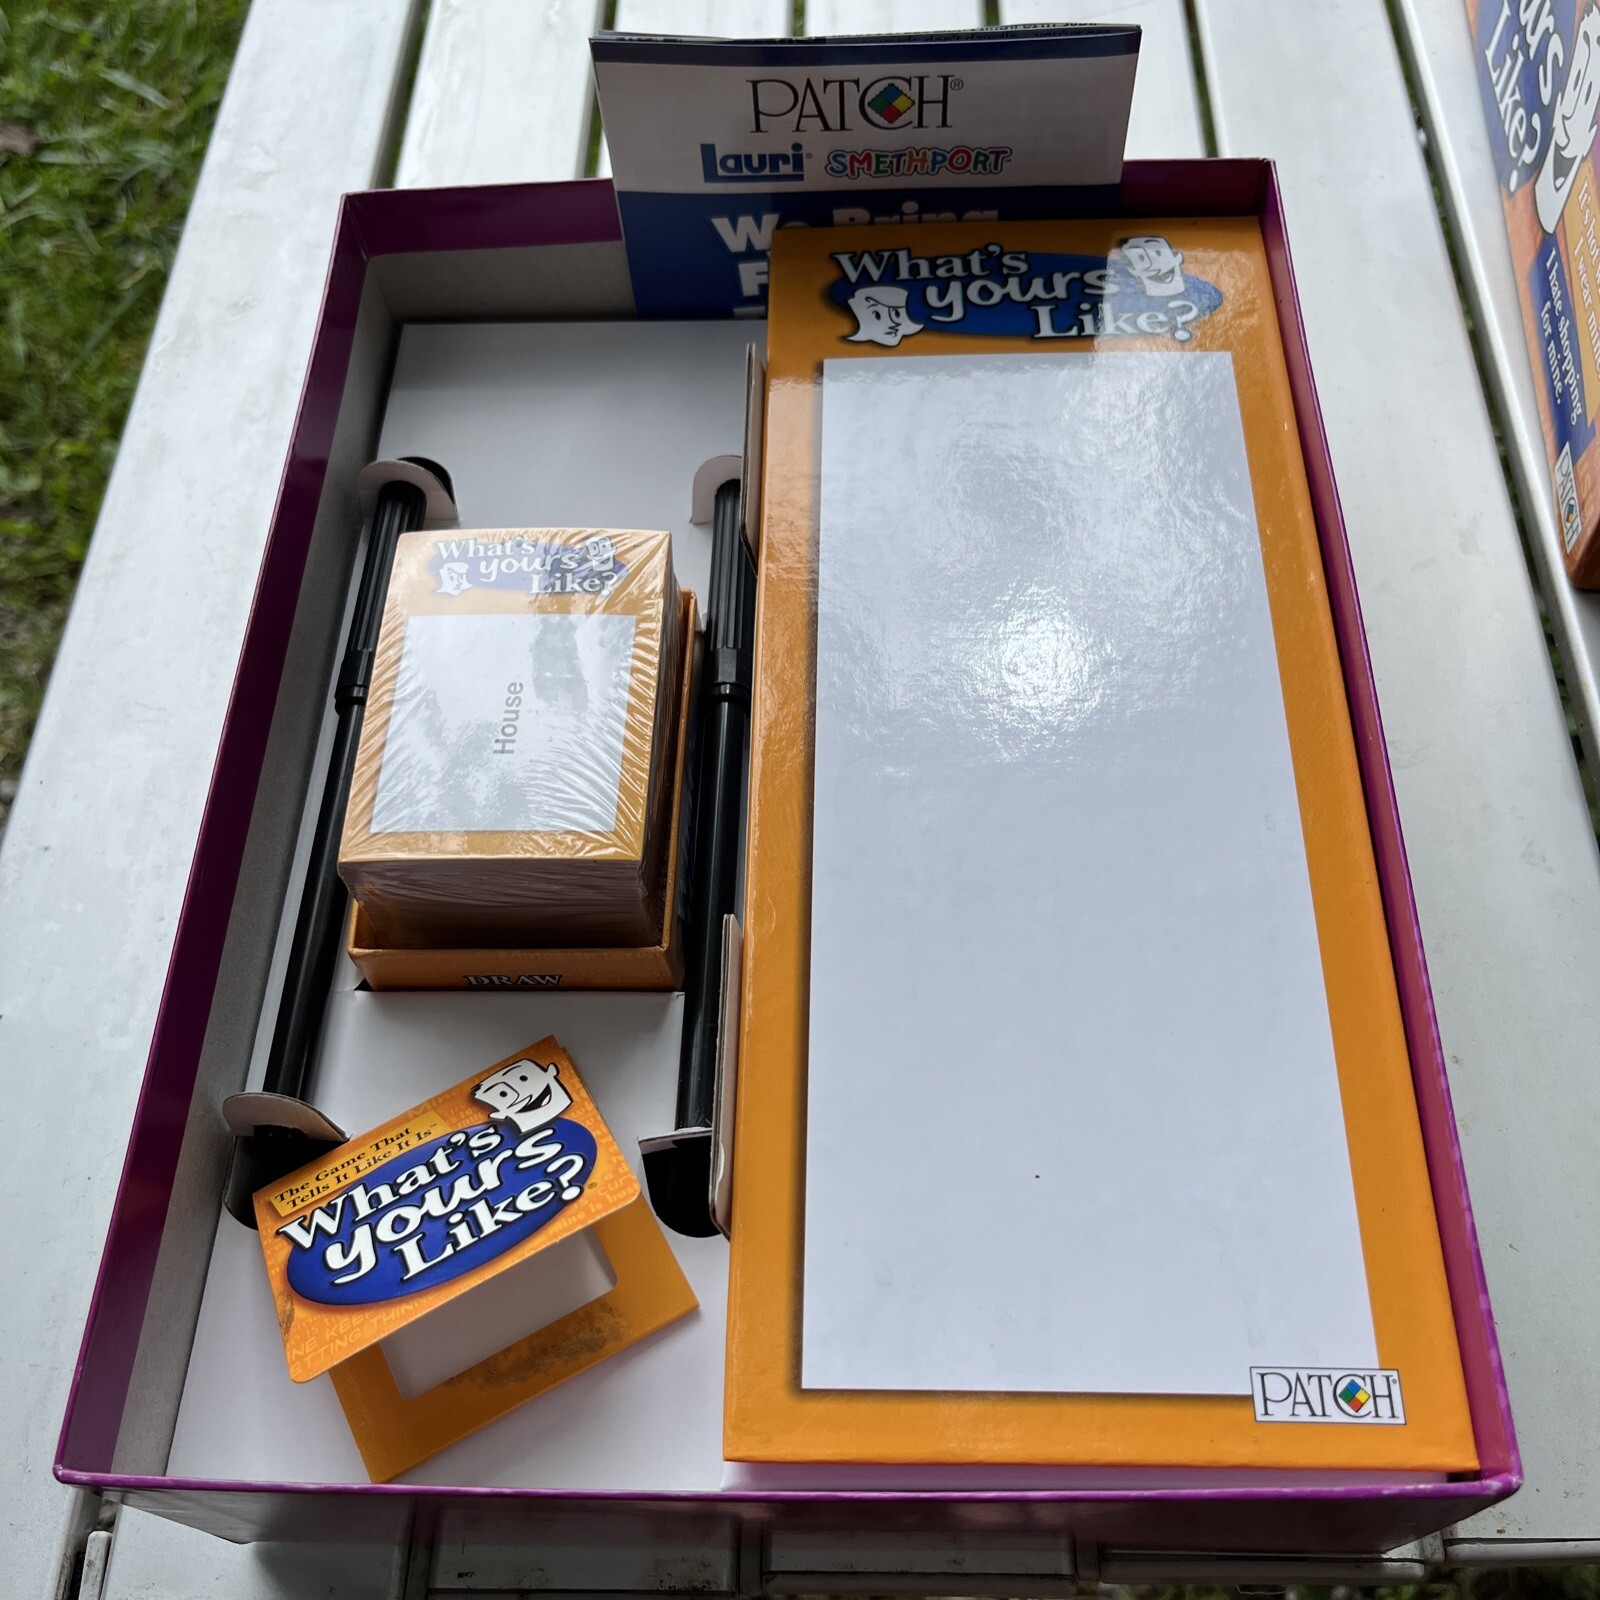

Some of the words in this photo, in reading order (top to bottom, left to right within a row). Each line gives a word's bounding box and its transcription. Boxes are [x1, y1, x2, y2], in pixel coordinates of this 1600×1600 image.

[746, 75, 955, 133] PATCH
[1485, 0, 1541, 193] Like?
[700, 143, 804, 183] Lauri
[825, 145, 1012, 179] SMETHPORT
[833, 243, 1030, 284] What's
[925, 270, 1122, 322] yours
[1030, 299, 1199, 342] Like?
[1541, 300, 1552, 338] for
[1547, 339, 1563, 405] mine.
[1549, 261, 1563, 317] hate
[1558, 315, 1582, 425] shopping
[1557, 450, 1579, 547] PATCH
[436, 534, 538, 560] What's
[478, 550, 582, 583] yours
[528, 571, 618, 597] Like?
[492, 681, 523, 756] House
[463, 973, 562, 987] DRAW
[275, 1181, 310, 1203] The
[315, 1151, 367, 1182] Game
[369, 1127, 412, 1151] That
[278, 1125, 502, 1252] What's
[286, 1183, 331, 1209] Tells
[335, 1173, 350, 1184] It
[355, 1151, 392, 1176] Like
[397, 1141, 412, 1151] It
[416, 1129, 433, 1141] Is
[323, 1127, 563, 1286] yours
[393, 1153, 585, 1282] Like?
[1256, 1371, 1400, 1419] PATCH
